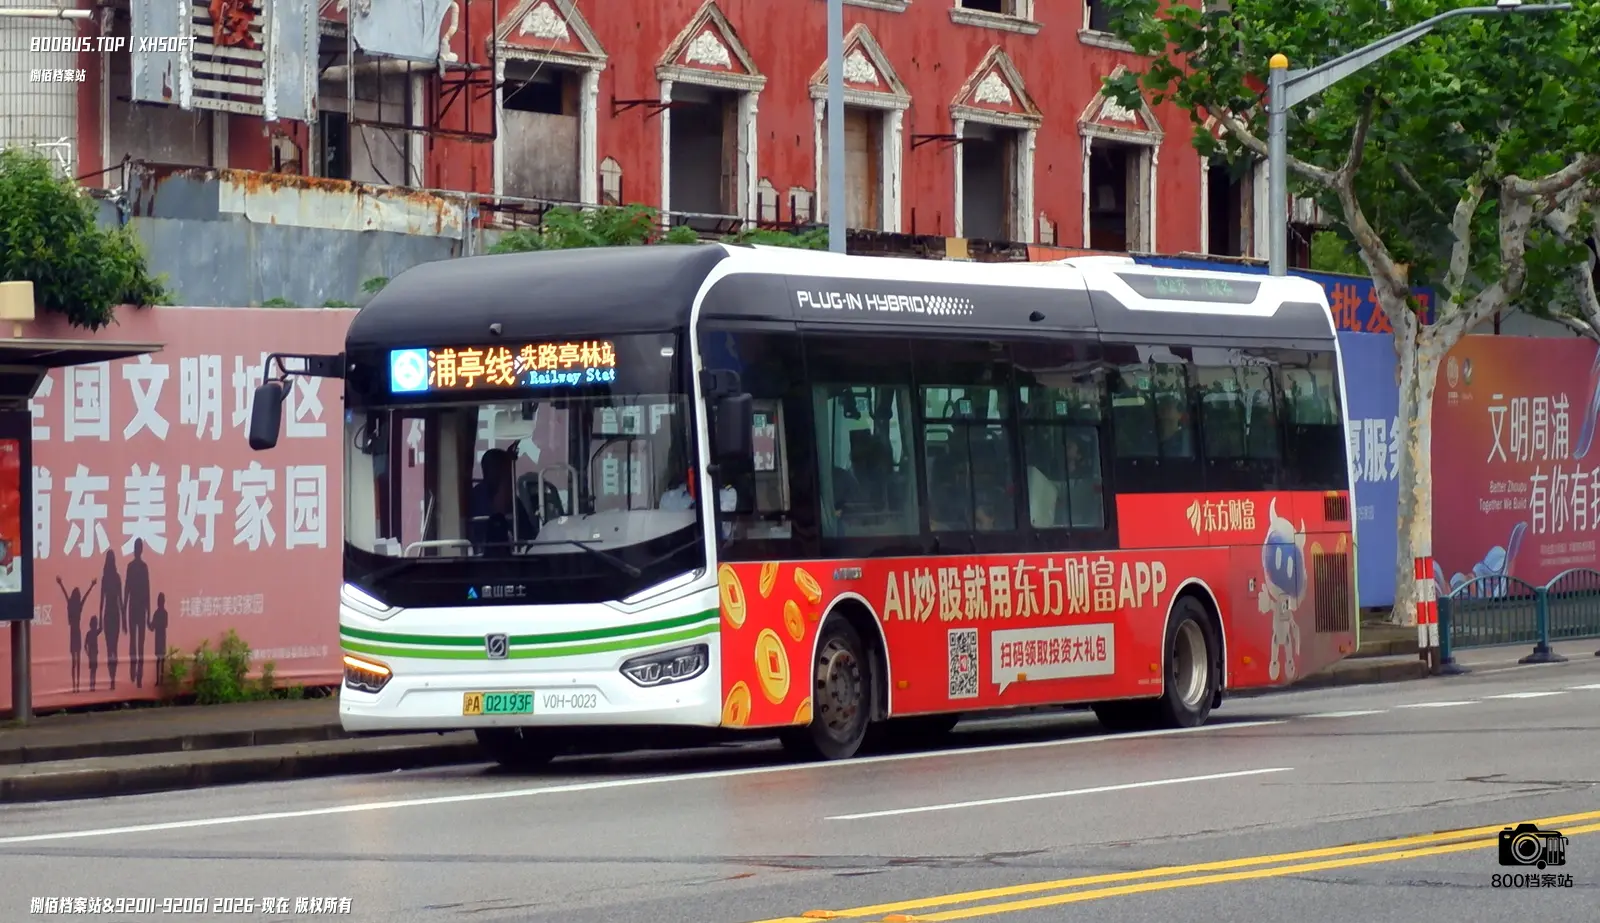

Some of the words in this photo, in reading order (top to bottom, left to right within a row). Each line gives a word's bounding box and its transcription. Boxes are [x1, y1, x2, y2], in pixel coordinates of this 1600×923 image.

[796, 290, 864, 311] PLUG-IN
[864, 293, 925, 313] HYBRID
[1320, 282, 1394, 334] 批发
[428, 347, 516, 388] 浦亭线
[529, 369, 582, 386] Railway
[1487, 391, 1570, 464] 文明周浦
[1203, 499, 1256, 532] 东方财富
[883, 556, 1168, 623] AI炒股就用东方财富APP
[1000, 635, 1107, 669] 扫码领取投资大礼包
